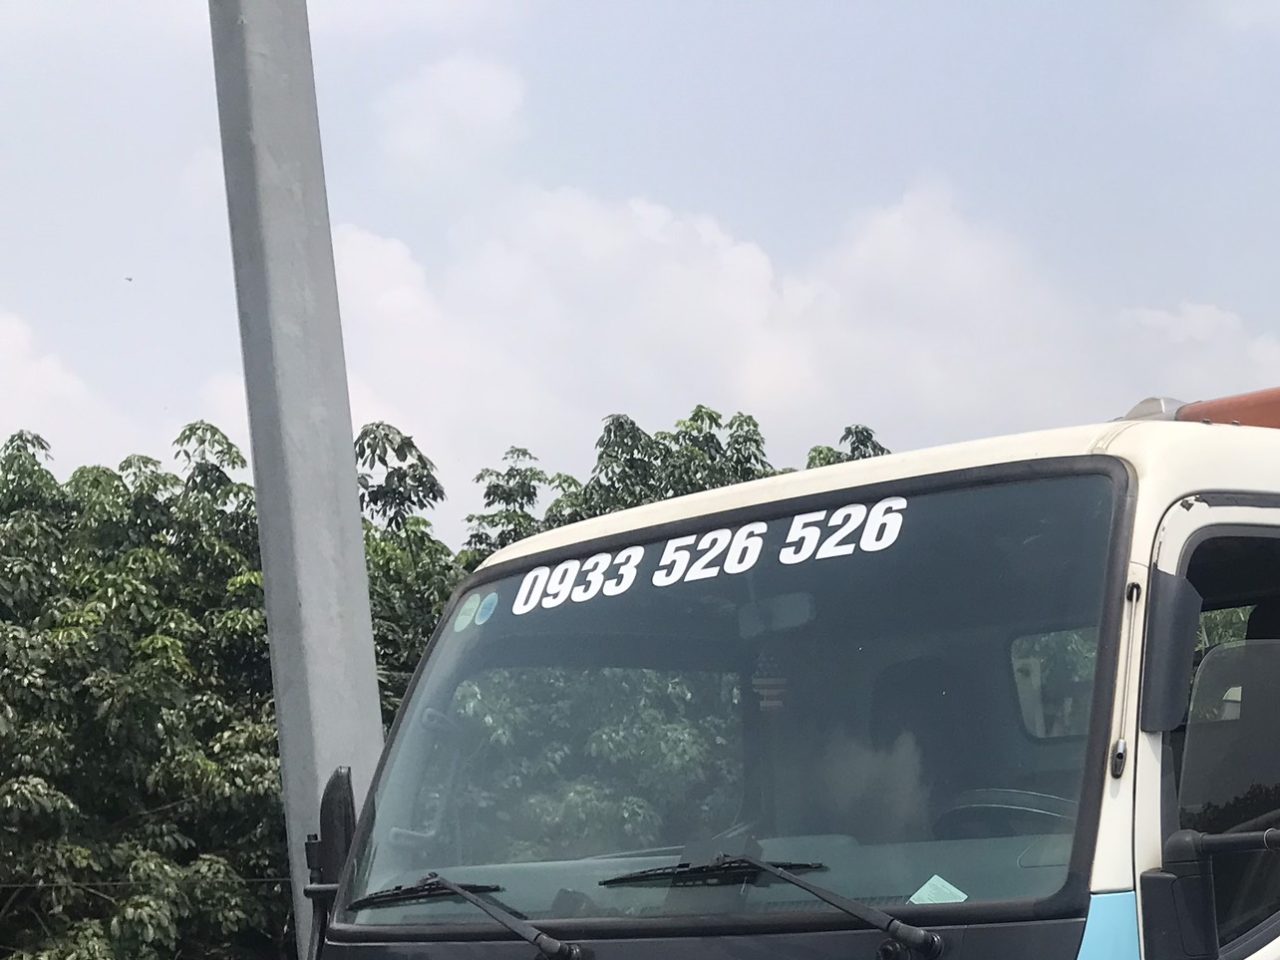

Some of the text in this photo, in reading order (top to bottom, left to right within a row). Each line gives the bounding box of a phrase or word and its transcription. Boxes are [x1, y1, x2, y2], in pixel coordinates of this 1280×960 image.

[511, 496, 907, 616] 0933 526 526
